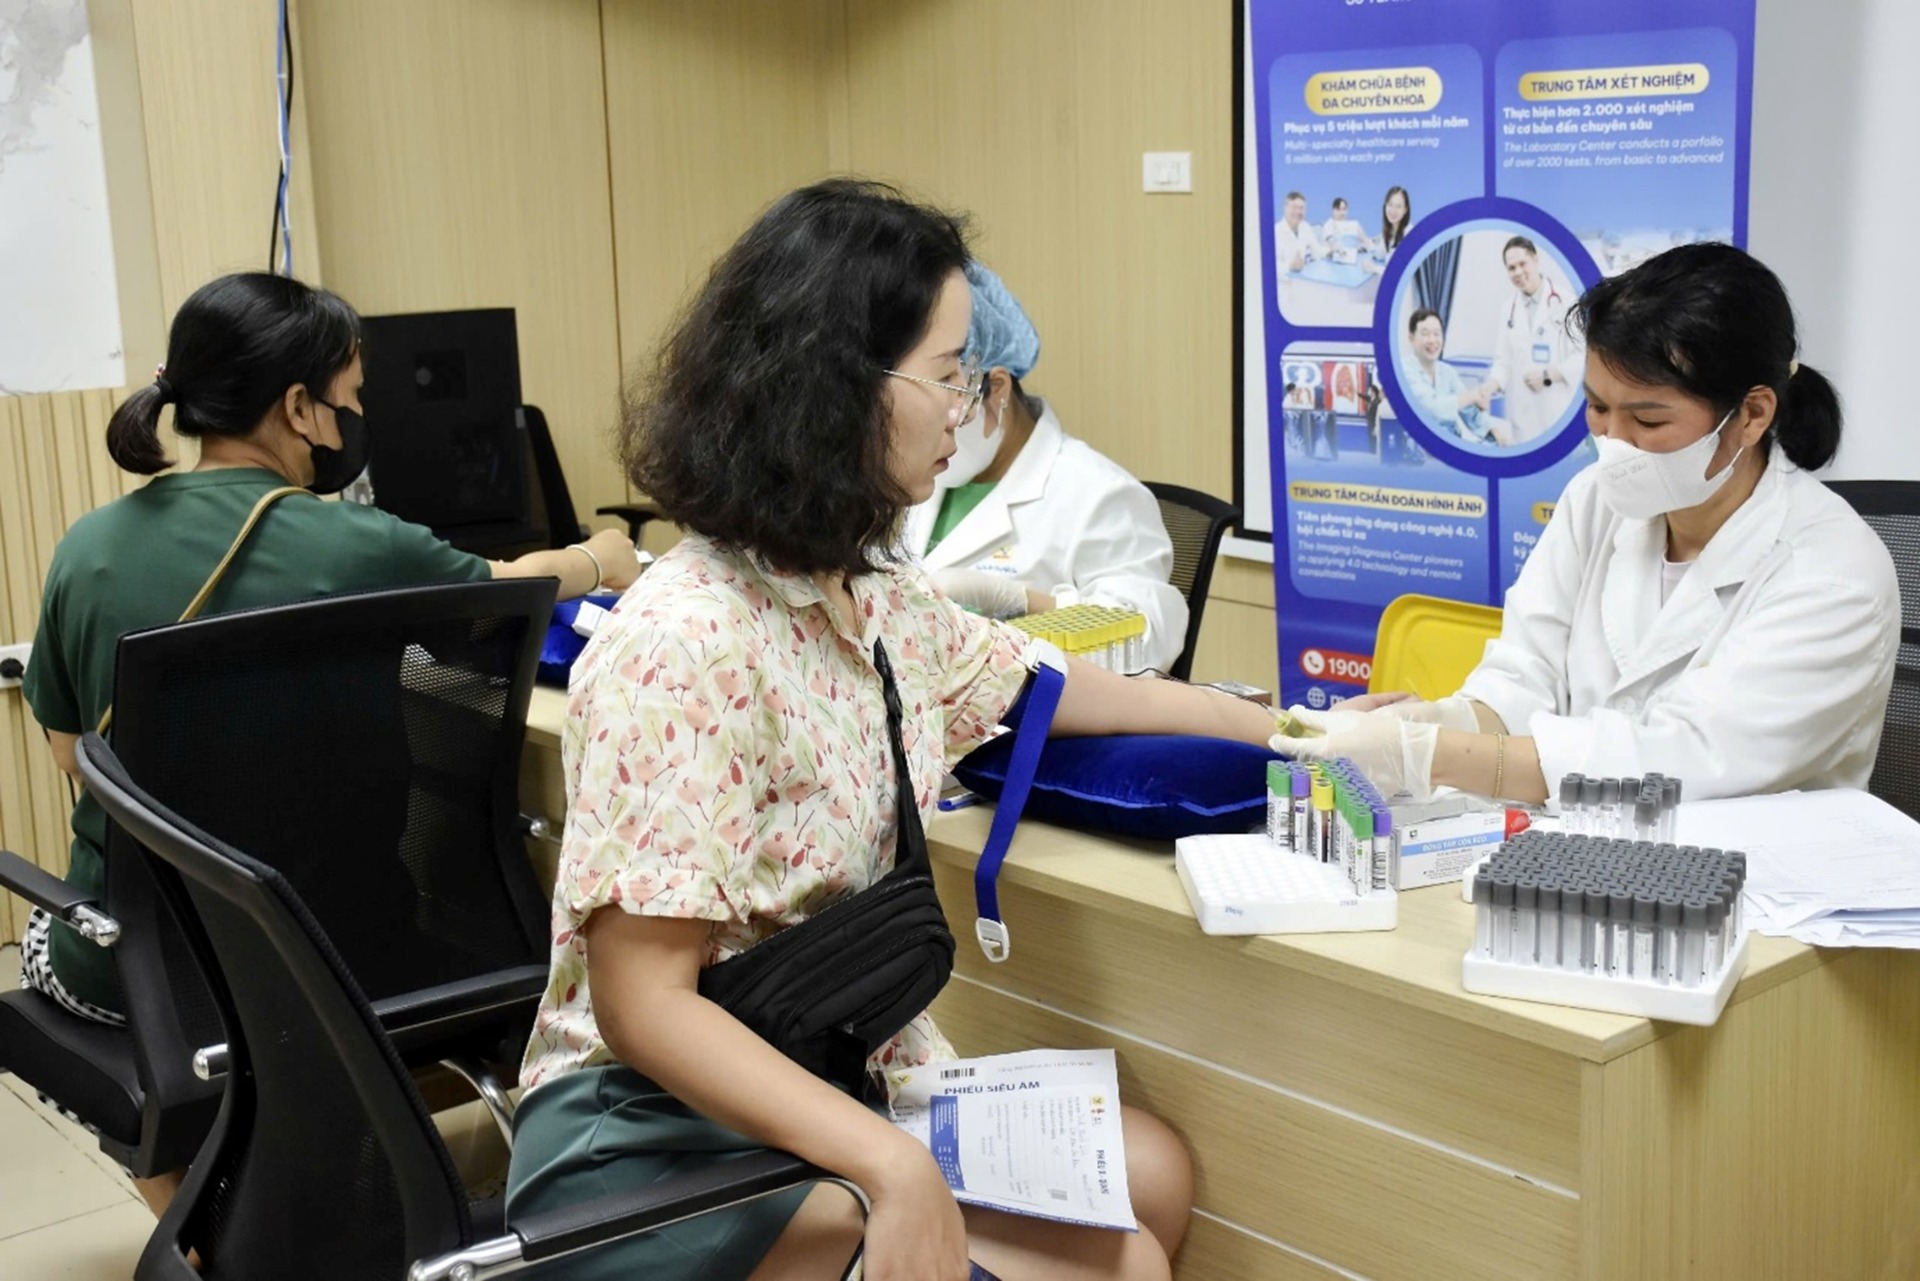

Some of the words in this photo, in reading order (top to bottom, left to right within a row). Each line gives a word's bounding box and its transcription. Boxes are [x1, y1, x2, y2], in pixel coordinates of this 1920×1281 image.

[1321, 78, 1356, 92] KHÁM
[1359, 75, 1392, 90] CHỮA
[1395, 74, 1426, 91] BỆNH
[1531, 80, 1574, 93] TRUNG
[1577, 77, 1607, 91] TÂM
[1611, 73, 1638, 89] XÉT
[1642, 71, 1695, 90] NGHIỆM
[1322, 98, 1339, 109] ĐA
[1342, 93, 1390, 108] CHUYÊN
[1393, 94, 1425, 106] KHOA
[1503, 106, 1531, 121] Thực
[1532, 105, 1556, 120] hiện
[1557, 105, 1581, 118] hơn
[1583, 103, 1623, 117] 2.000
[1625, 102, 1647, 115] xét
[1649, 100, 1694, 116] nghiệm
[1443, 115, 1469, 128] năm
[1555, 119, 1578, 134] đến
[1580, 119, 1627, 135] chuyên
[1629, 117, 1653, 132] sâu
[1523, 141, 1577, 154] Laboratory
[1578, 139, 1617, 152] Center
[1618, 137, 1670, 150] conducts
[1537, 155, 1562, 168] 2000
[1594, 155, 1623, 167] from
[1623, 153, 1654, 166] basic
[1655, 153, 1668, 165] to
[1669, 151, 1725, 164] advanced
[1293, 486, 1331, 499] TRUNG
[1334, 488, 1357, 500] TÂM
[1391, 493, 1424, 508] ĐOÁN
[1328, 657, 1372, 680] 1900
